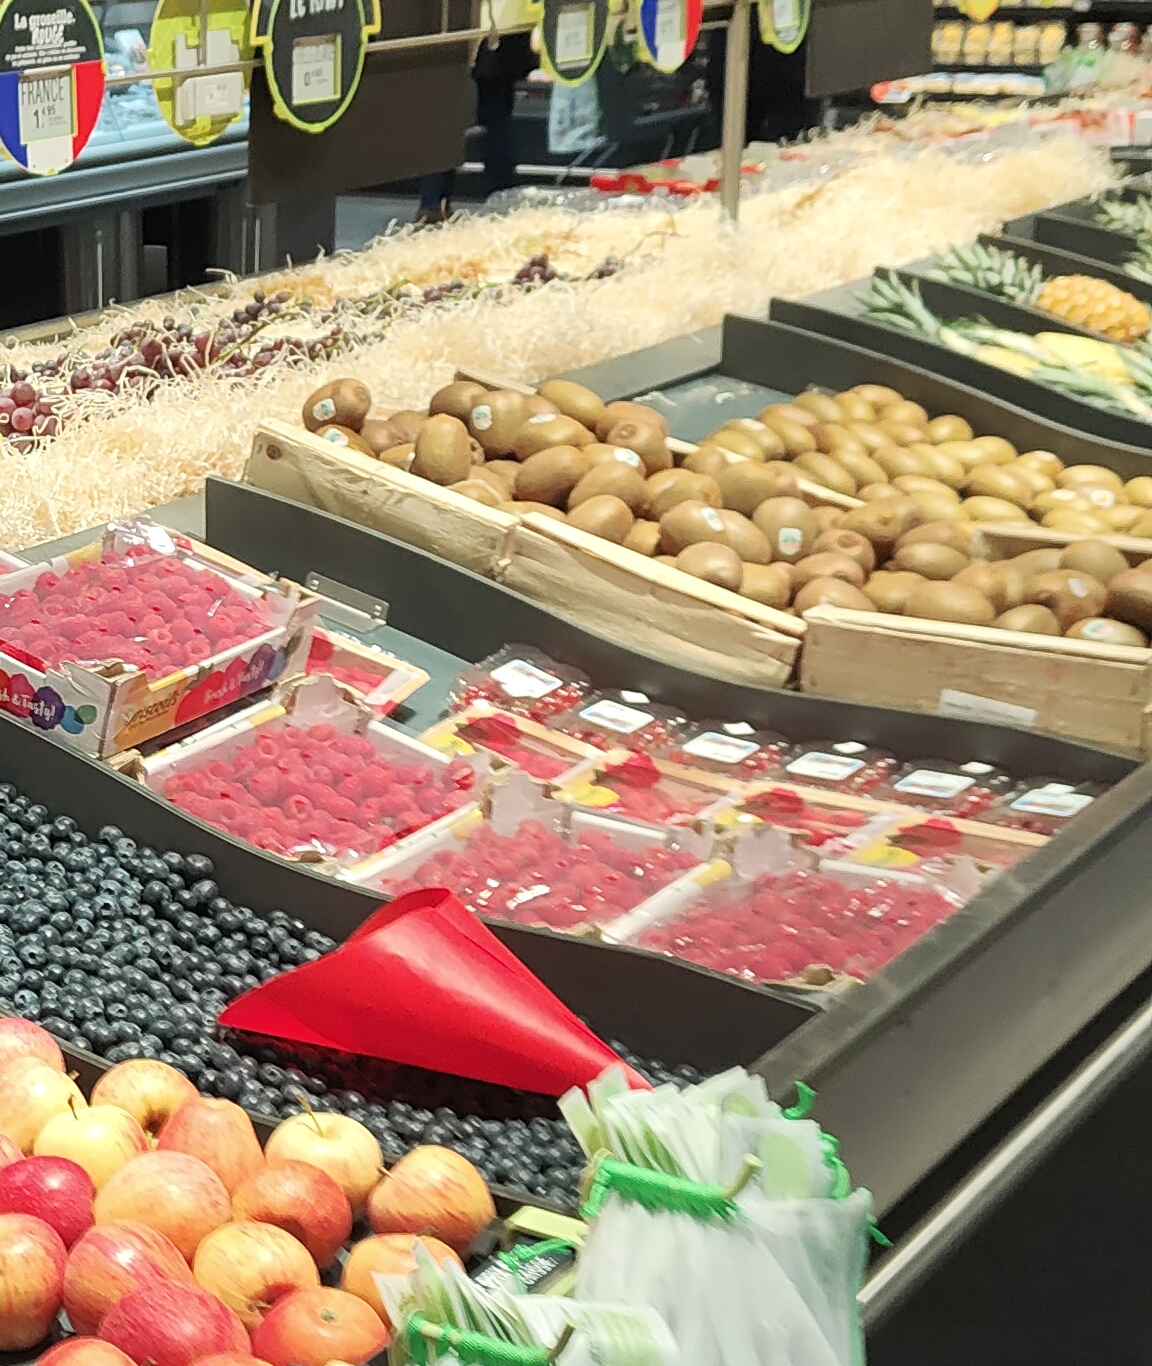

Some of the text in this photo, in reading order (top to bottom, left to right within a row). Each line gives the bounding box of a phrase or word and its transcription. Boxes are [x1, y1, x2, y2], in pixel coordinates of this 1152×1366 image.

[14, 12, 28, 31] La
[21, 76, 64, 106] FRANCE
[21, 695, 56, 722] Tasty!
